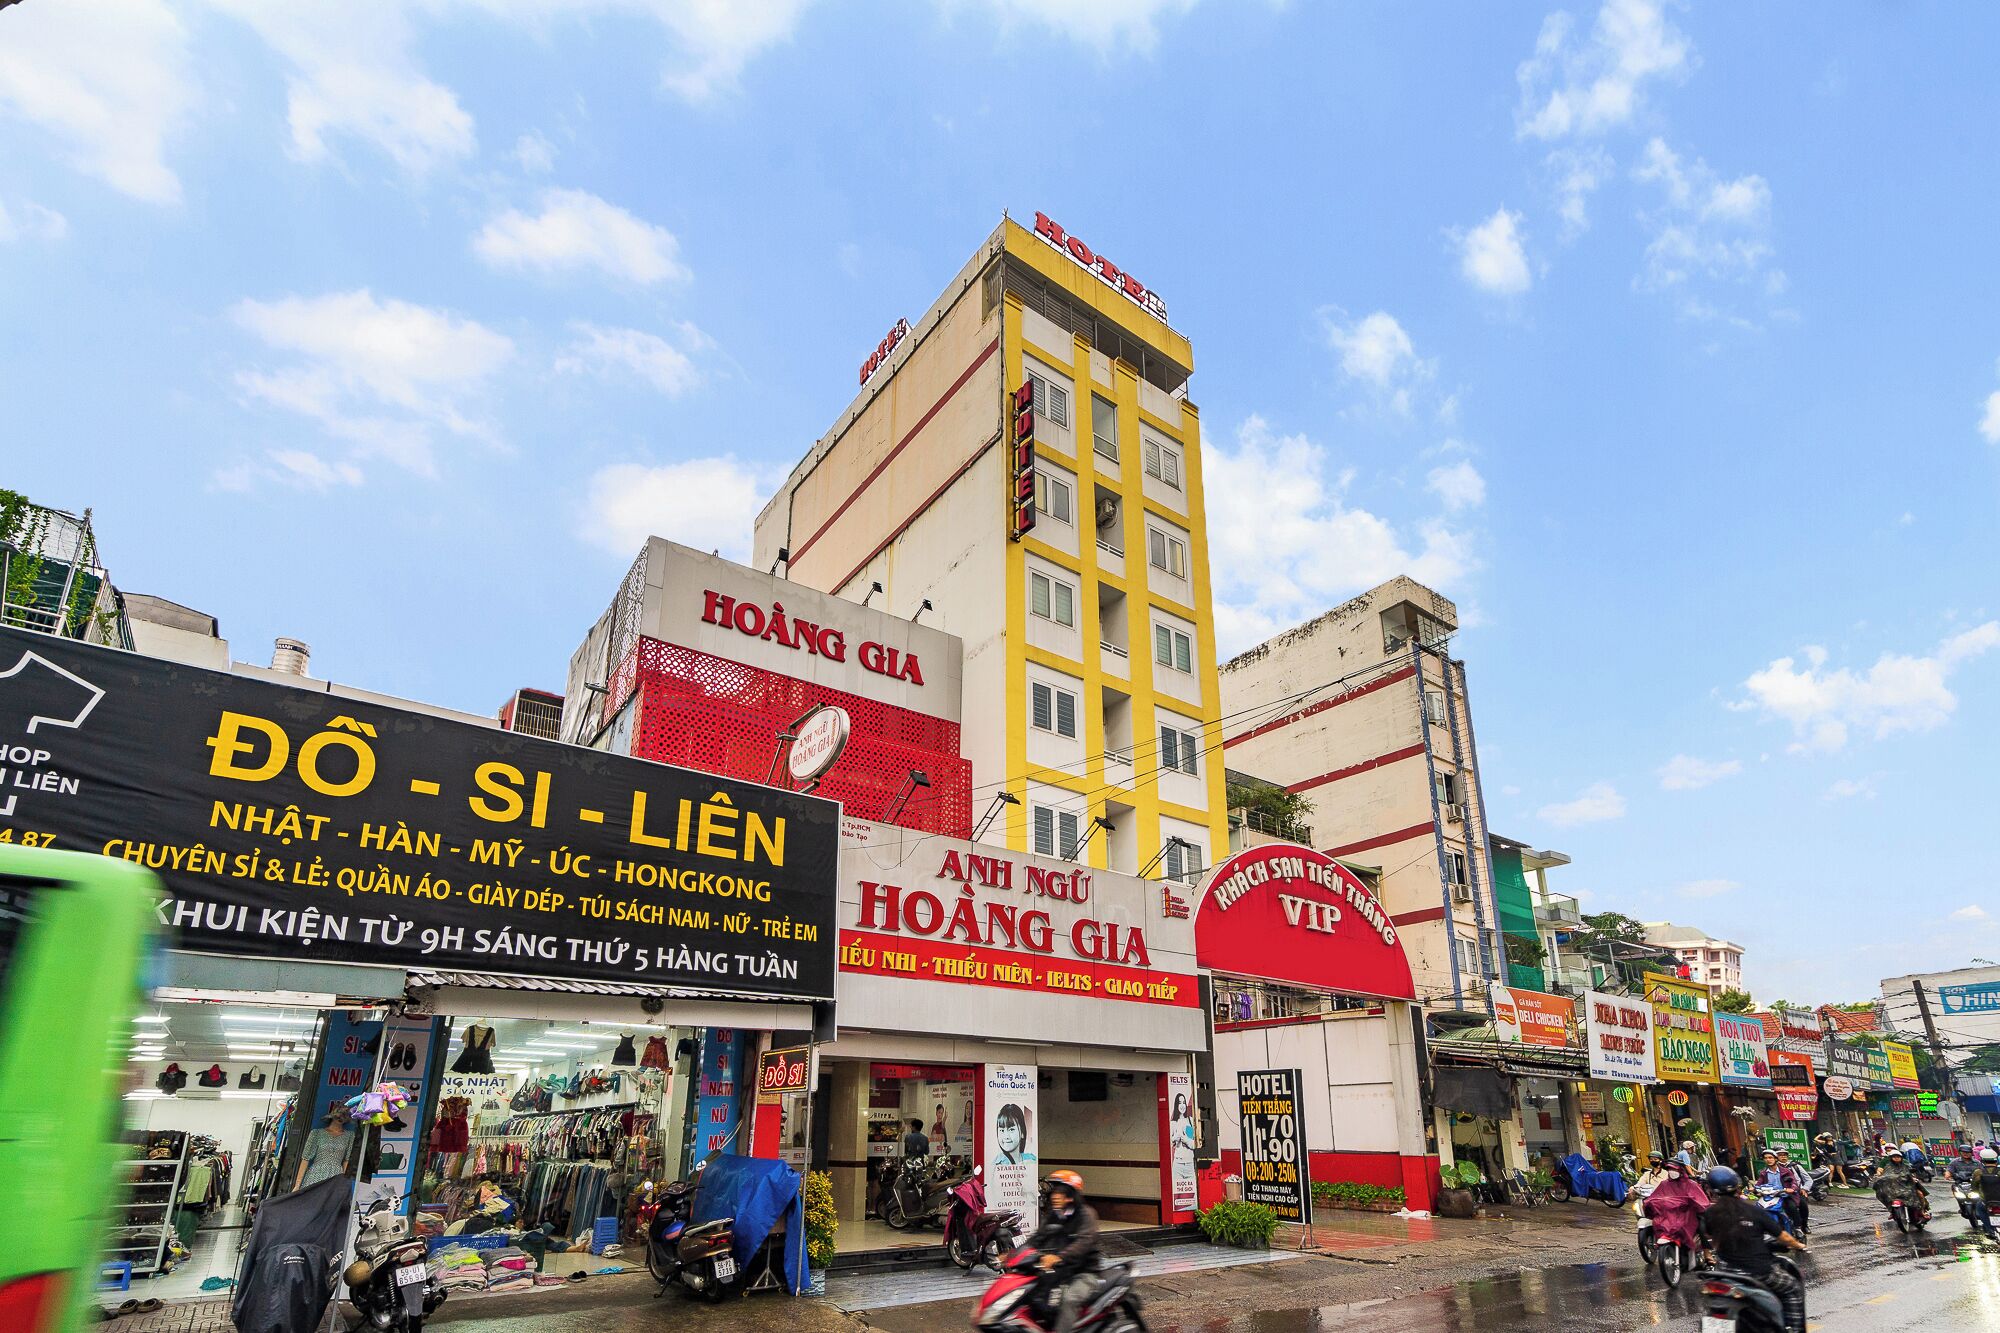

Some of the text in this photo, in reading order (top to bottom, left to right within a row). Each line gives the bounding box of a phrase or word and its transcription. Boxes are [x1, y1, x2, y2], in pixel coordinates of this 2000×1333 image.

[1015, 379, 1035, 535] HOTEL
[701, 589, 925, 686] HOÀNG GIA
[14, 770, 80, 796] LIÊN
[206, 710, 378, 797] ĐỒ
[468, 761, 551, 829] SI
[629, 790, 786, 867] LIÊN
[209, 800, 331, 846] NHẬT
[360, 820, 441, 858] HÀN
[469, 838, 525, 868] MỸ
[549, 845, 591, 878] ÚC
[614, 860, 772, 902] HONGKONG
[936, 850, 1092, 905] ANH NGỮ
[1213, 860, 1270, 911] KHÁCH
[1269, 856, 1305, 884] SẠN
[232, 848, 260, 880] SỈ
[264, 857, 285, 882] &
[337, 862, 410, 897] QUẦN
[416, 873, 451, 901] ÁO
[468, 881, 519, 908] GIÀY
[523, 885, 564, 912] DÉP
[579, 893, 611, 918] TÚI
[615, 898, 664, 925] SÁCH
[669, 906, 709, 930] NAM
[723, 912, 751, 934] NỮ
[762, 914, 791, 940] TRẺ
[794, 922, 818, 941] EM
[856, 880, 1152, 966] HOÀNG GIA
[1278, 893, 1342, 935] VIP
[258, 905, 349, 946] KIỆN
[358, 914, 414, 946] TỪ
[420, 924, 465, 955] 9H
[472, 925, 558, 960] SÁNG
[565, 937, 630, 966] THỨ
[634, 947, 649, 972] 5
[656, 944, 729, 975] HÀNG
[734, 949, 799, 980] TUẦN
[881, 950, 918, 973] NHI
[932, 953, 989, 980] THIẾU
[993, 962, 1033, 986] NIÊN
[1047, 970, 1093, 992] IELTS
[1104, 978, 1144, 998] GIAO
[1146, 978, 1178, 1001] TIẾP
[1519, 1010, 1535, 1023] DELI
[1535, 1012, 1564, 1028] CHICKEN
[1594, 1002, 1619, 1026] NHA
[1619, 1007, 1648, 1031] KHOA
[1719, 1019, 1740, 1040] HOA
[344, 1036, 359, 1054] SI
[1659, 1027, 1684, 1061] BẢO
[1684, 1039, 1712, 1069] NGỌC
[717, 1054, 729, 1070] SI
[328, 1068, 363, 1087] NAM
[467, 1077, 508, 1090] NHẬT
[787, 1063, 804, 1086] SI
[1015, 1072, 1028, 1080] Anh
[1170, 1076, 1189, 1084] IELTS
[1240, 1073, 1292, 1096] HOTEL
[708, 1081, 734, 1096] NAM
[711, 1104, 729, 1123] NỮ
[1242, 1096, 1262, 1115] TIẾN
[1267, 1114, 1294, 1138] 70
[1268, 1138, 1296, 1163] 90
[1790, 1142, 1805, 1150] SINH
[1252, 1183, 1260, 1192] CÓ
[1260, 1185, 1279, 1194] THANG
[1261, 1193, 1275, 1202] NGHI
[1275, 1195, 1286, 1203] CAO
